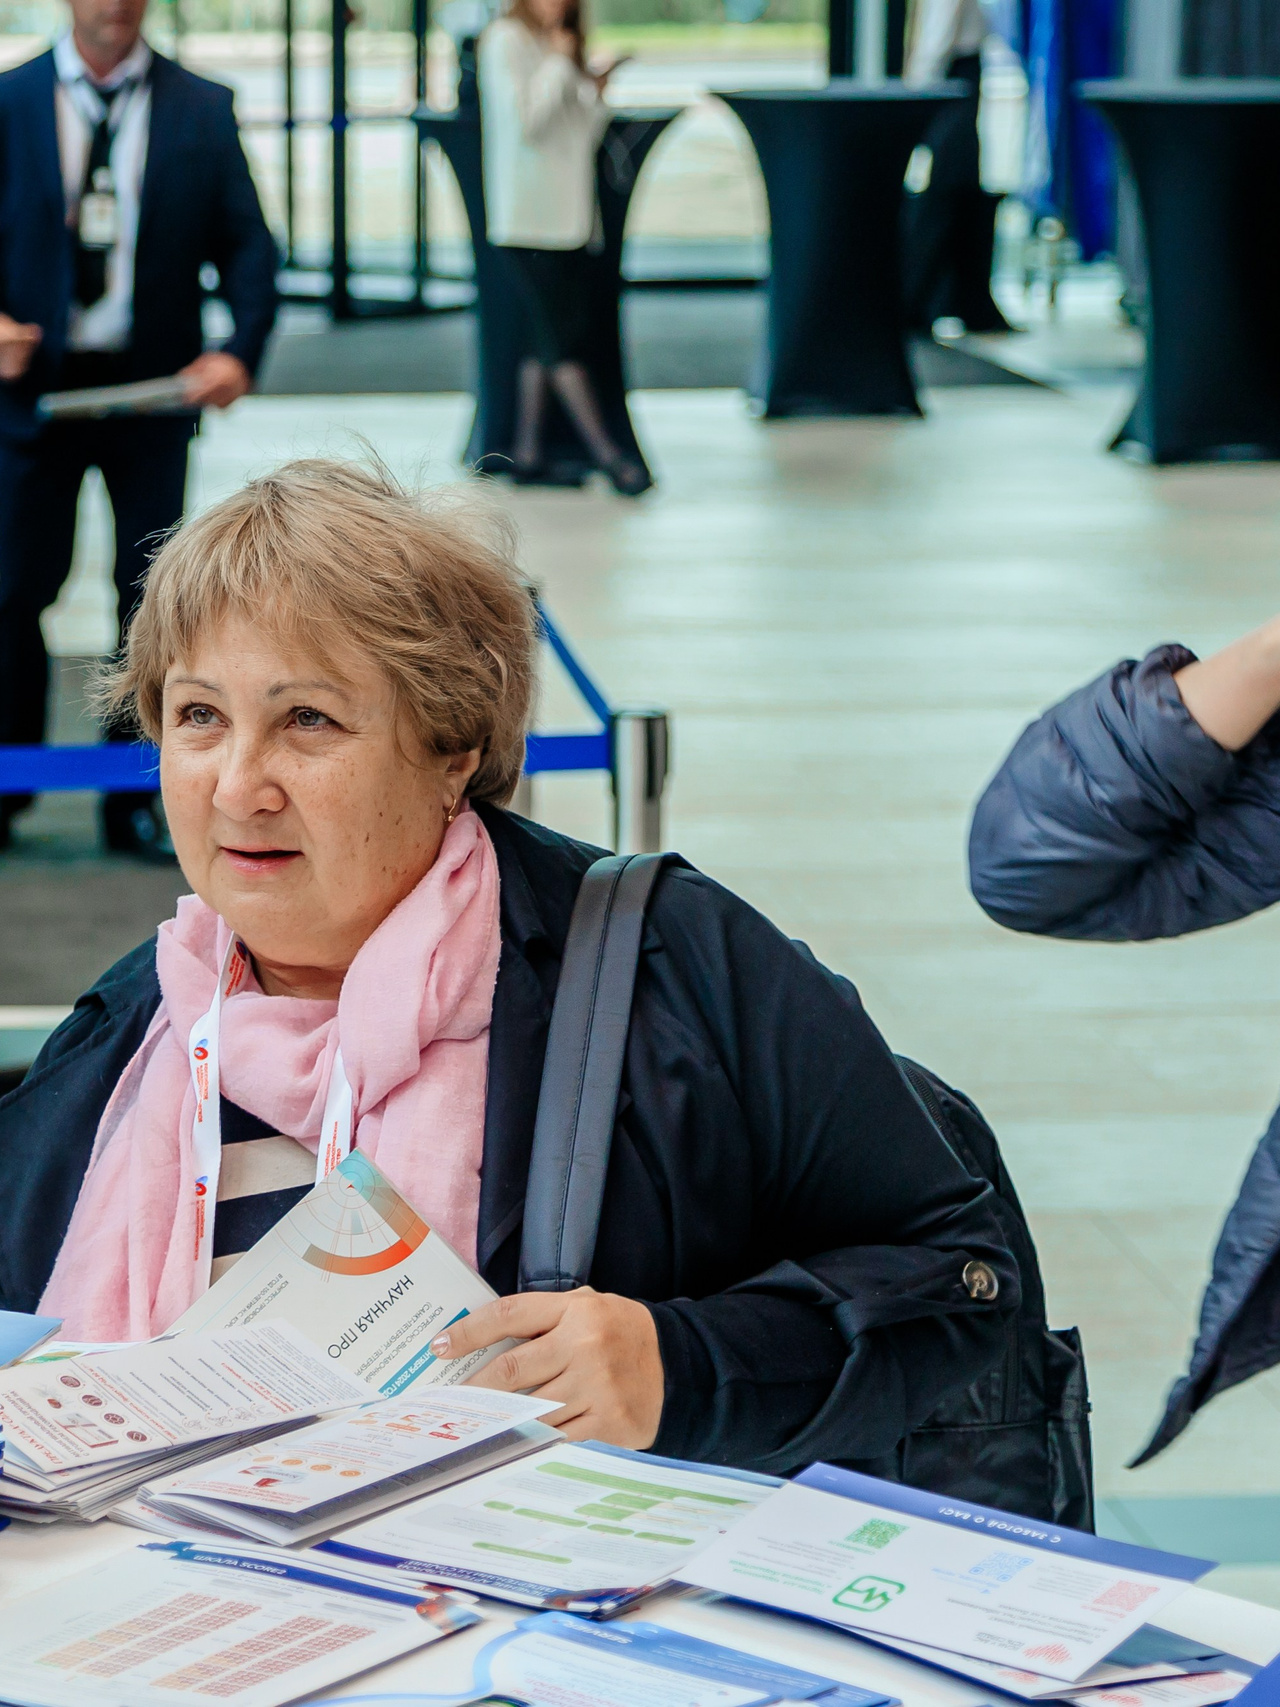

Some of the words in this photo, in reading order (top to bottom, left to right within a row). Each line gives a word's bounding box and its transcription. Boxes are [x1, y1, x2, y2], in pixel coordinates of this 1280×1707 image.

[263, 1279, 289, 1304] КОНГРЕСС
[267, 1276, 279, 1288] ГОД
[245, 1285, 269, 1309] 150-ЛЕТИЯ
[353, 1273, 414, 1334] НАУЧНАЯ
[362, 1304, 445, 1383] КОНГРЕССНО-ВЫСТАВОЧНЫЙ
[393, 1369, 411, 1387] 2024
[937, 1506, 971, 1520] ВАС!
[974, 1515, 985, 1524] О
[986, 1518, 1048, 1540] ЗАБОТОЙ
[1051, 1535, 1062, 1544] С
[240, 1561, 287, 1576] SCORE2
[562, 1620, 631, 1645] SERVIER
